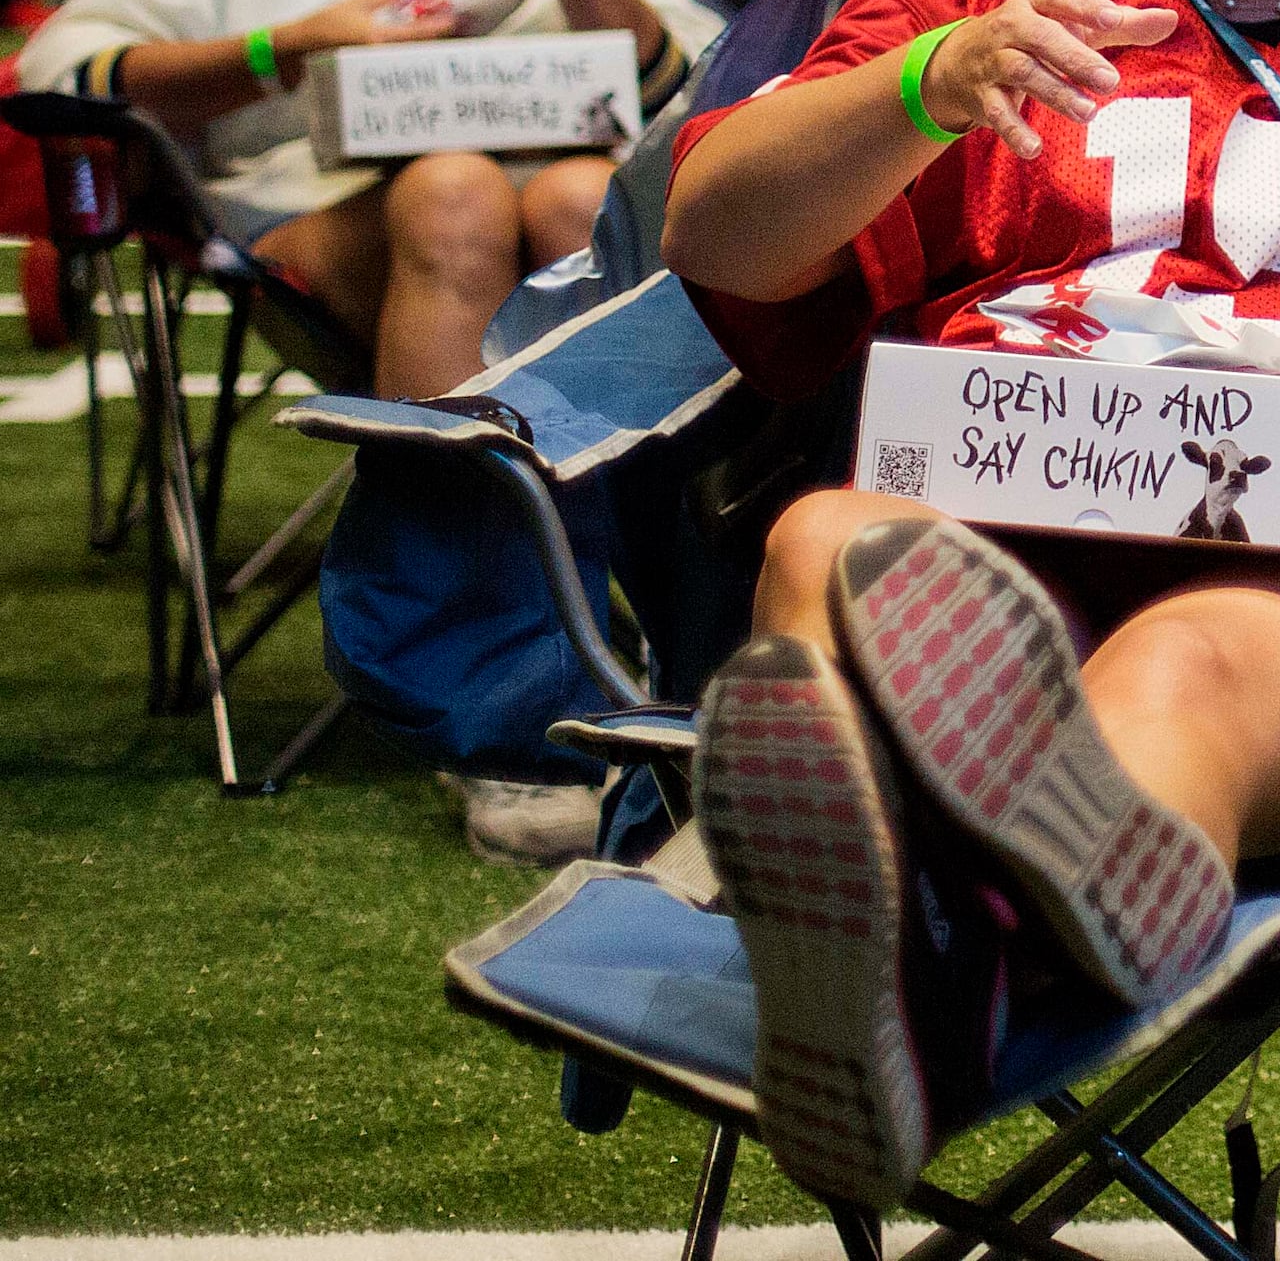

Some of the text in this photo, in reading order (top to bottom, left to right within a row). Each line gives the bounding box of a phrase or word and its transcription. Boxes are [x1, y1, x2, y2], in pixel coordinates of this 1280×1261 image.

[962, 366, 1253, 436] OPEN UP AND
[952, 425, 1176, 500] SAY CHIKIN
